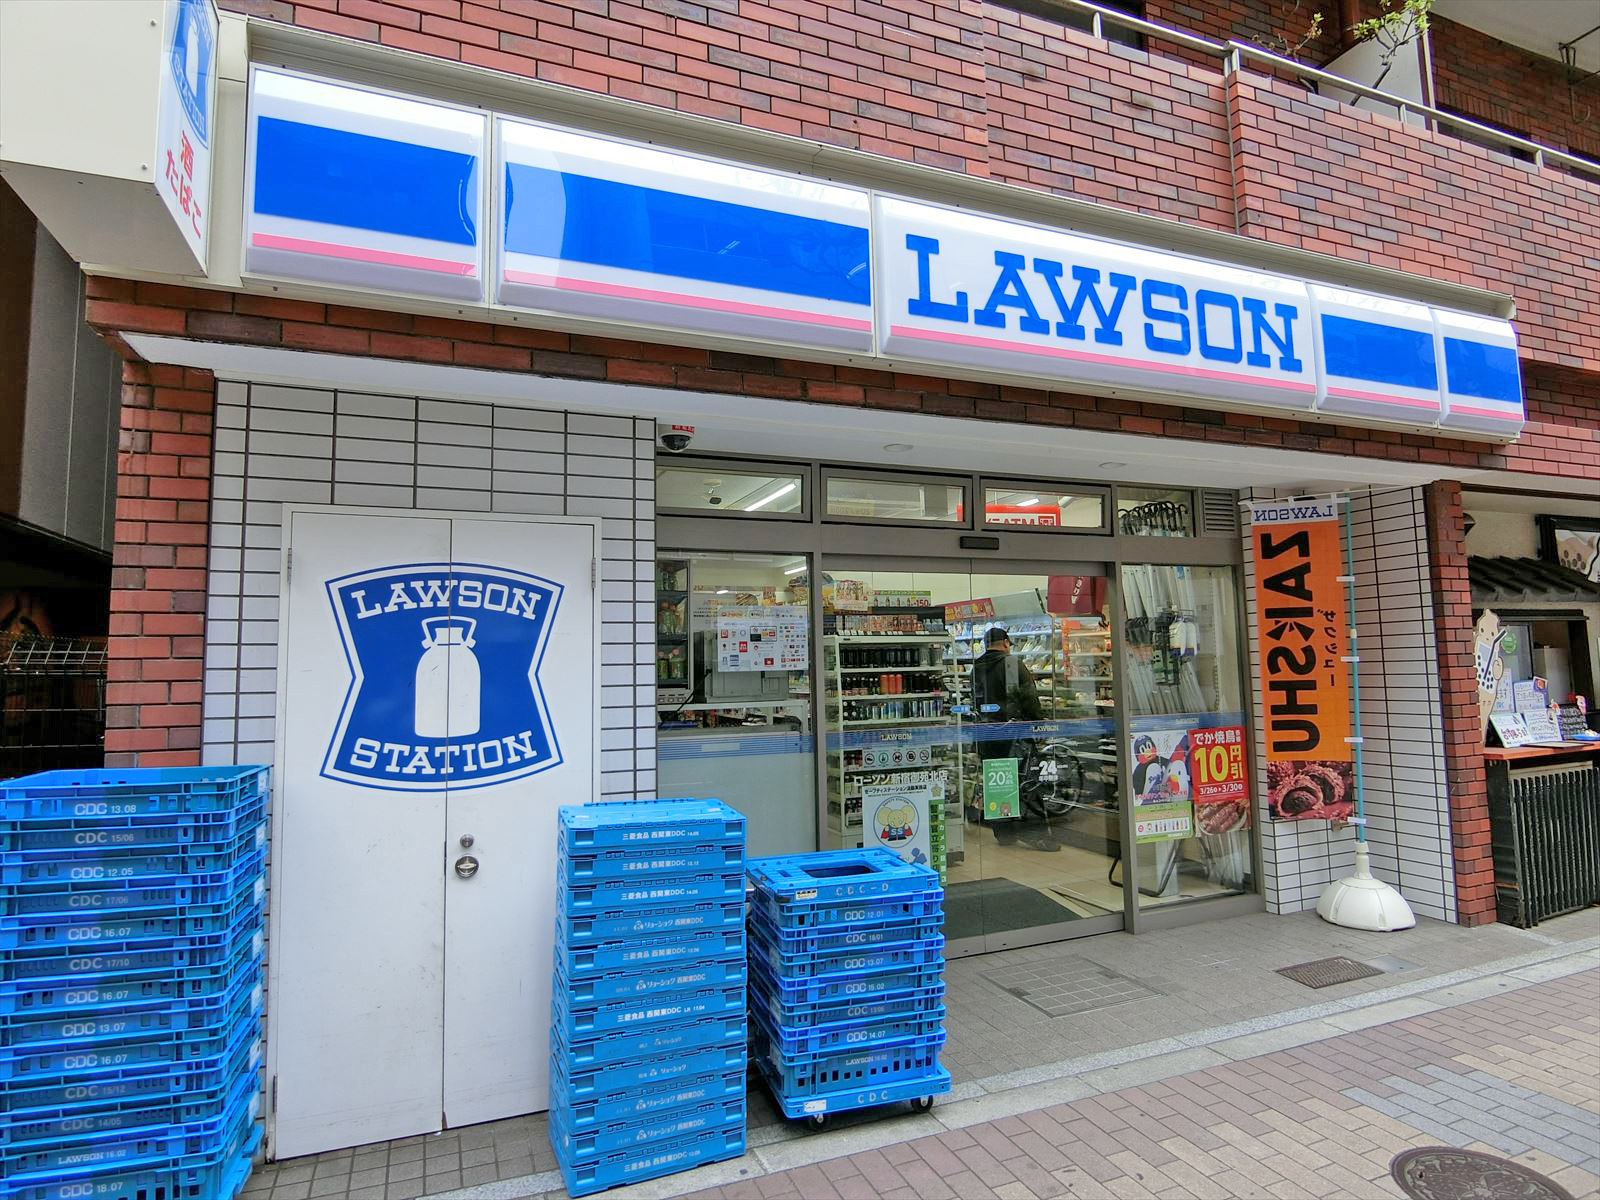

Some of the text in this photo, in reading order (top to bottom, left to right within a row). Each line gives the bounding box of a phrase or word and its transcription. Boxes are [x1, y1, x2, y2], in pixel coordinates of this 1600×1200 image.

[181, 130, 194, 183] 酒
[166, 148, 202, 240] たばこ
[905, 233, 1302, 373] LAWSON
[351, 579, 542, 620] LAWSON
[1032, 725, 1059, 733] LAWSON
[881, 733, 912, 741] LAWSON
[350, 730, 538, 775] STATION
[1038, 760, 1058, 776] 24
[1194, 745, 1228, 783] 10
[853, 770, 948, 786] ローソン新宿御苑北店
[74, 803, 137, 816] CDC 13.08
[890, 827, 903, 835] SS
[74, 832, 107, 844] CDC
[71, 867, 134, 879] CDC 12.05
[69, 894, 102, 907] CDC
[844, 911, 866, 921] CDC
[68, 927, 131, 940] CDC 16.07
[846, 934, 866, 944] CDC
[69, 958, 102, 971] CDC
[844, 958, 866, 969] CDC
[846, 983, 866, 994] CDC
[65, 990, 129, 1004] CDC 16.07
[848, 1006, 868, 1017] CDC
[62, 1022, 126, 1037] CDC 13.07
[846, 1032, 868, 1043] CDC
[64, 1054, 98, 1069] CDC
[65, 1085, 98, 1099] CDC
[61, 1117, 95, 1131] CDC
[58, 1151, 104, 1165] LAWSON
[60, 1183, 94, 1198] CDC
